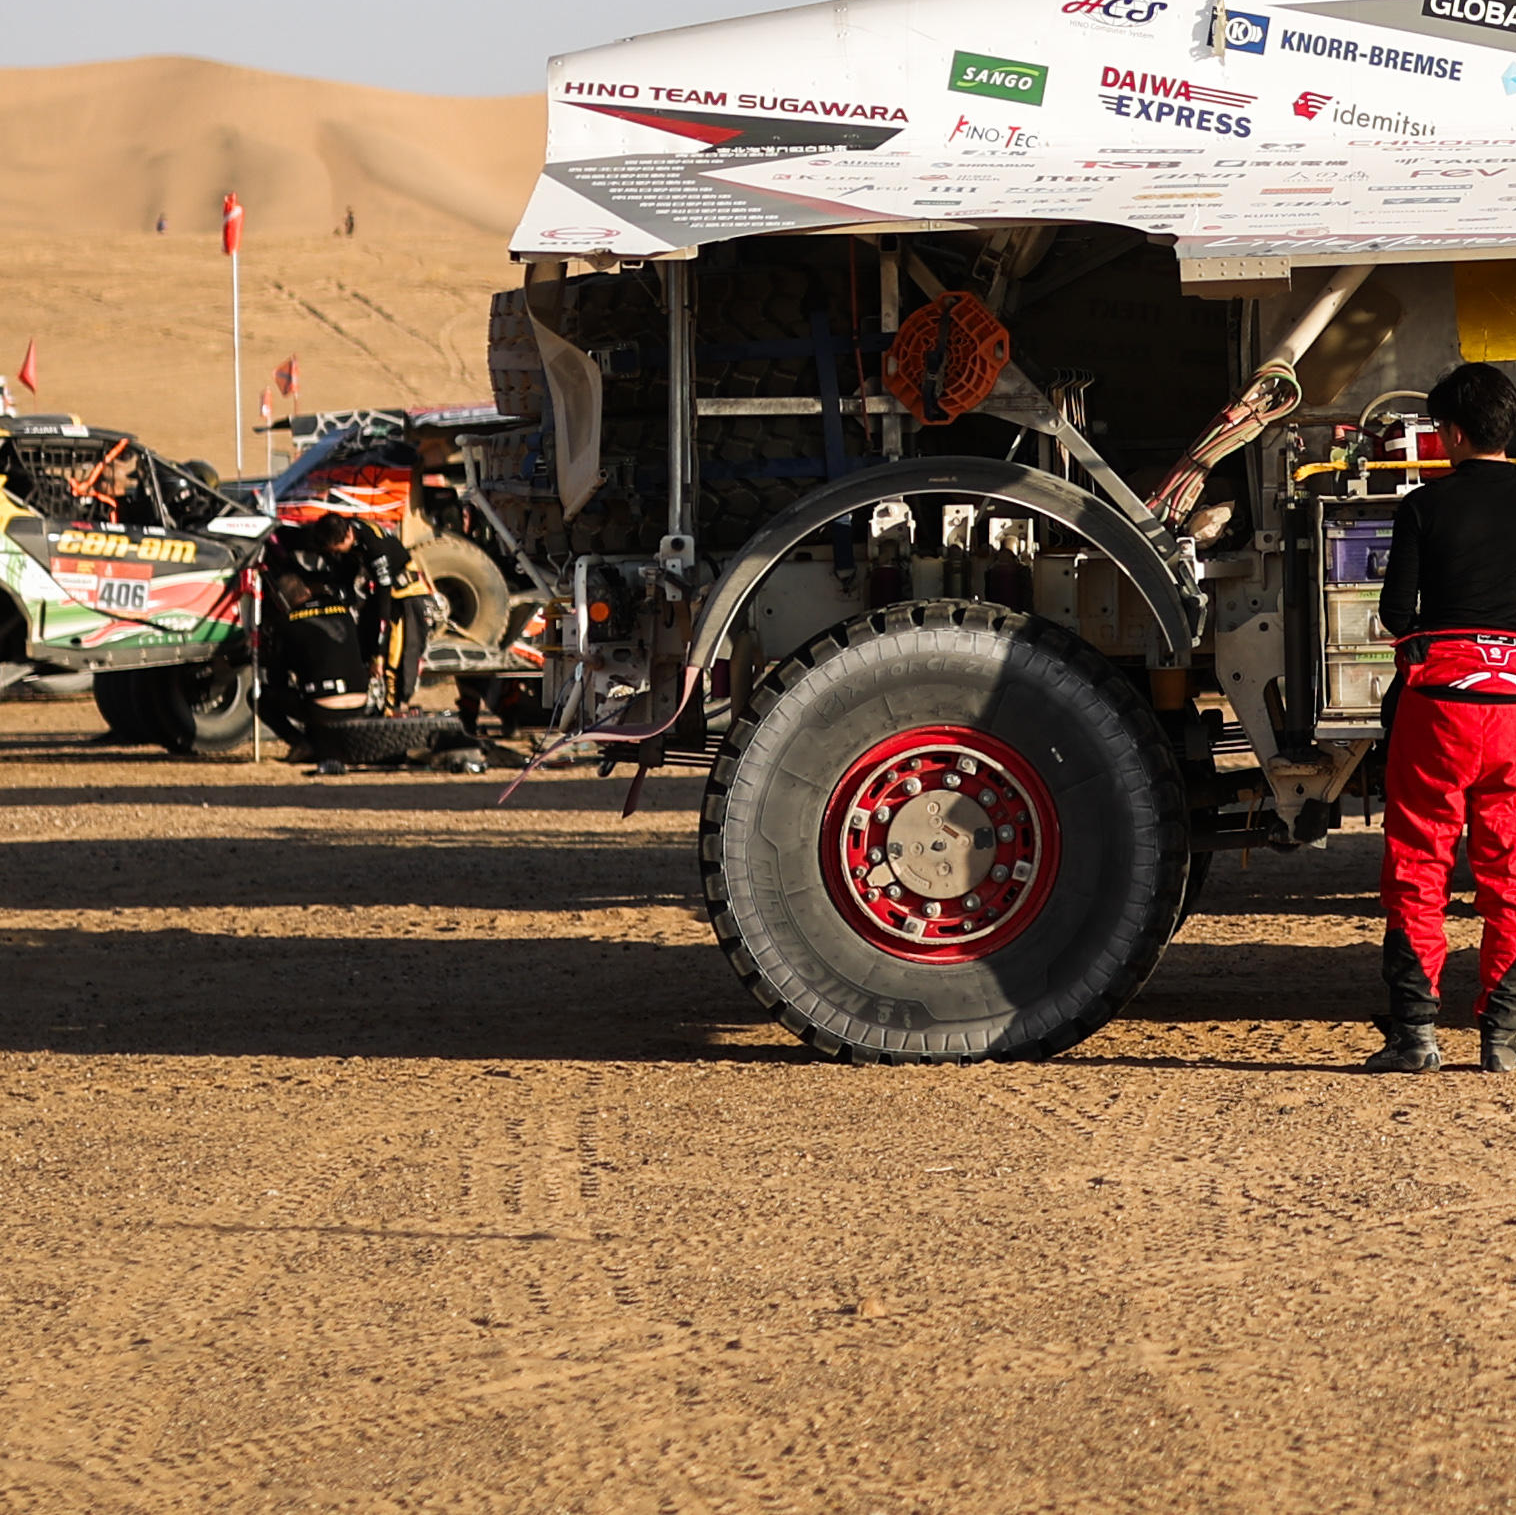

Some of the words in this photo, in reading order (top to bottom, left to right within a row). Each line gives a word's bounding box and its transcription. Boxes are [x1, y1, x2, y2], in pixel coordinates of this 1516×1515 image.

[1280, 29, 1463, 81] KNORR-BREMSE
[962, 66, 1033, 91] SANGO
[1100, 66, 1192, 101] DAIWA
[564, 82, 639, 99] HINO
[649, 86, 727, 106] TEAM
[737, 94, 909, 123] SUGAWARA
[1115, 94, 1251, 138] EXPRESS
[1333, 101, 1436, 136] idemitsu
[1074, 160, 1182, 169] TSB
[57, 530, 196, 563] can-am
[100, 582, 145, 608] 406
